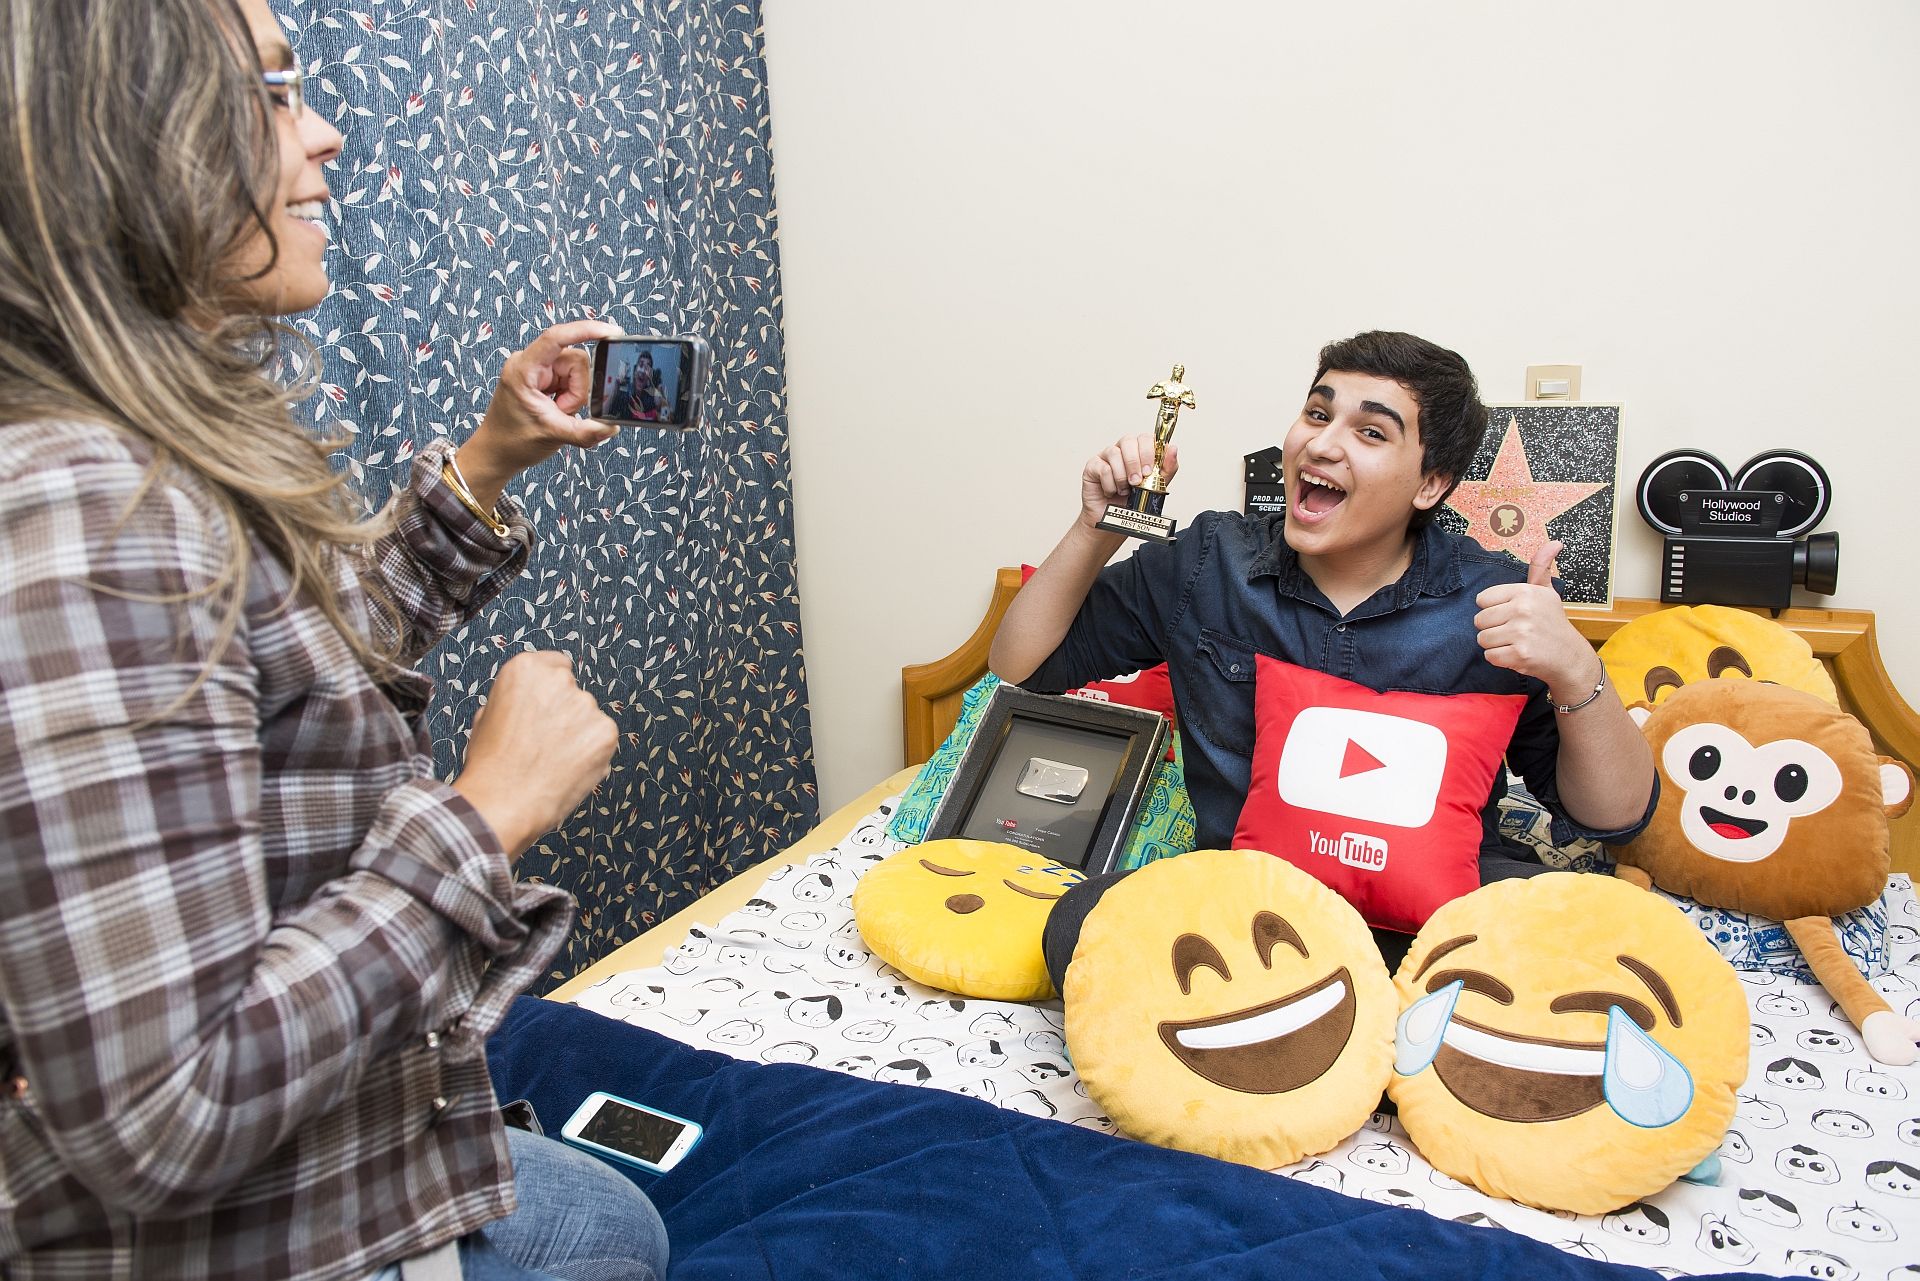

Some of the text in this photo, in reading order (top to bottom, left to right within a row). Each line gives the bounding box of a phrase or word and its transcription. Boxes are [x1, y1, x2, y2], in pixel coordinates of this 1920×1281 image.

[1481, 487, 1535, 499] FELIPE
[1702, 498, 1761, 512] Hollywood
[1114, 508, 1166, 524] HOLLYWOOD
[1709, 510, 1752, 522] Studios
[1120, 519, 1151, 532] BEST SON
[1309, 830, 1386, 868] YouTube
